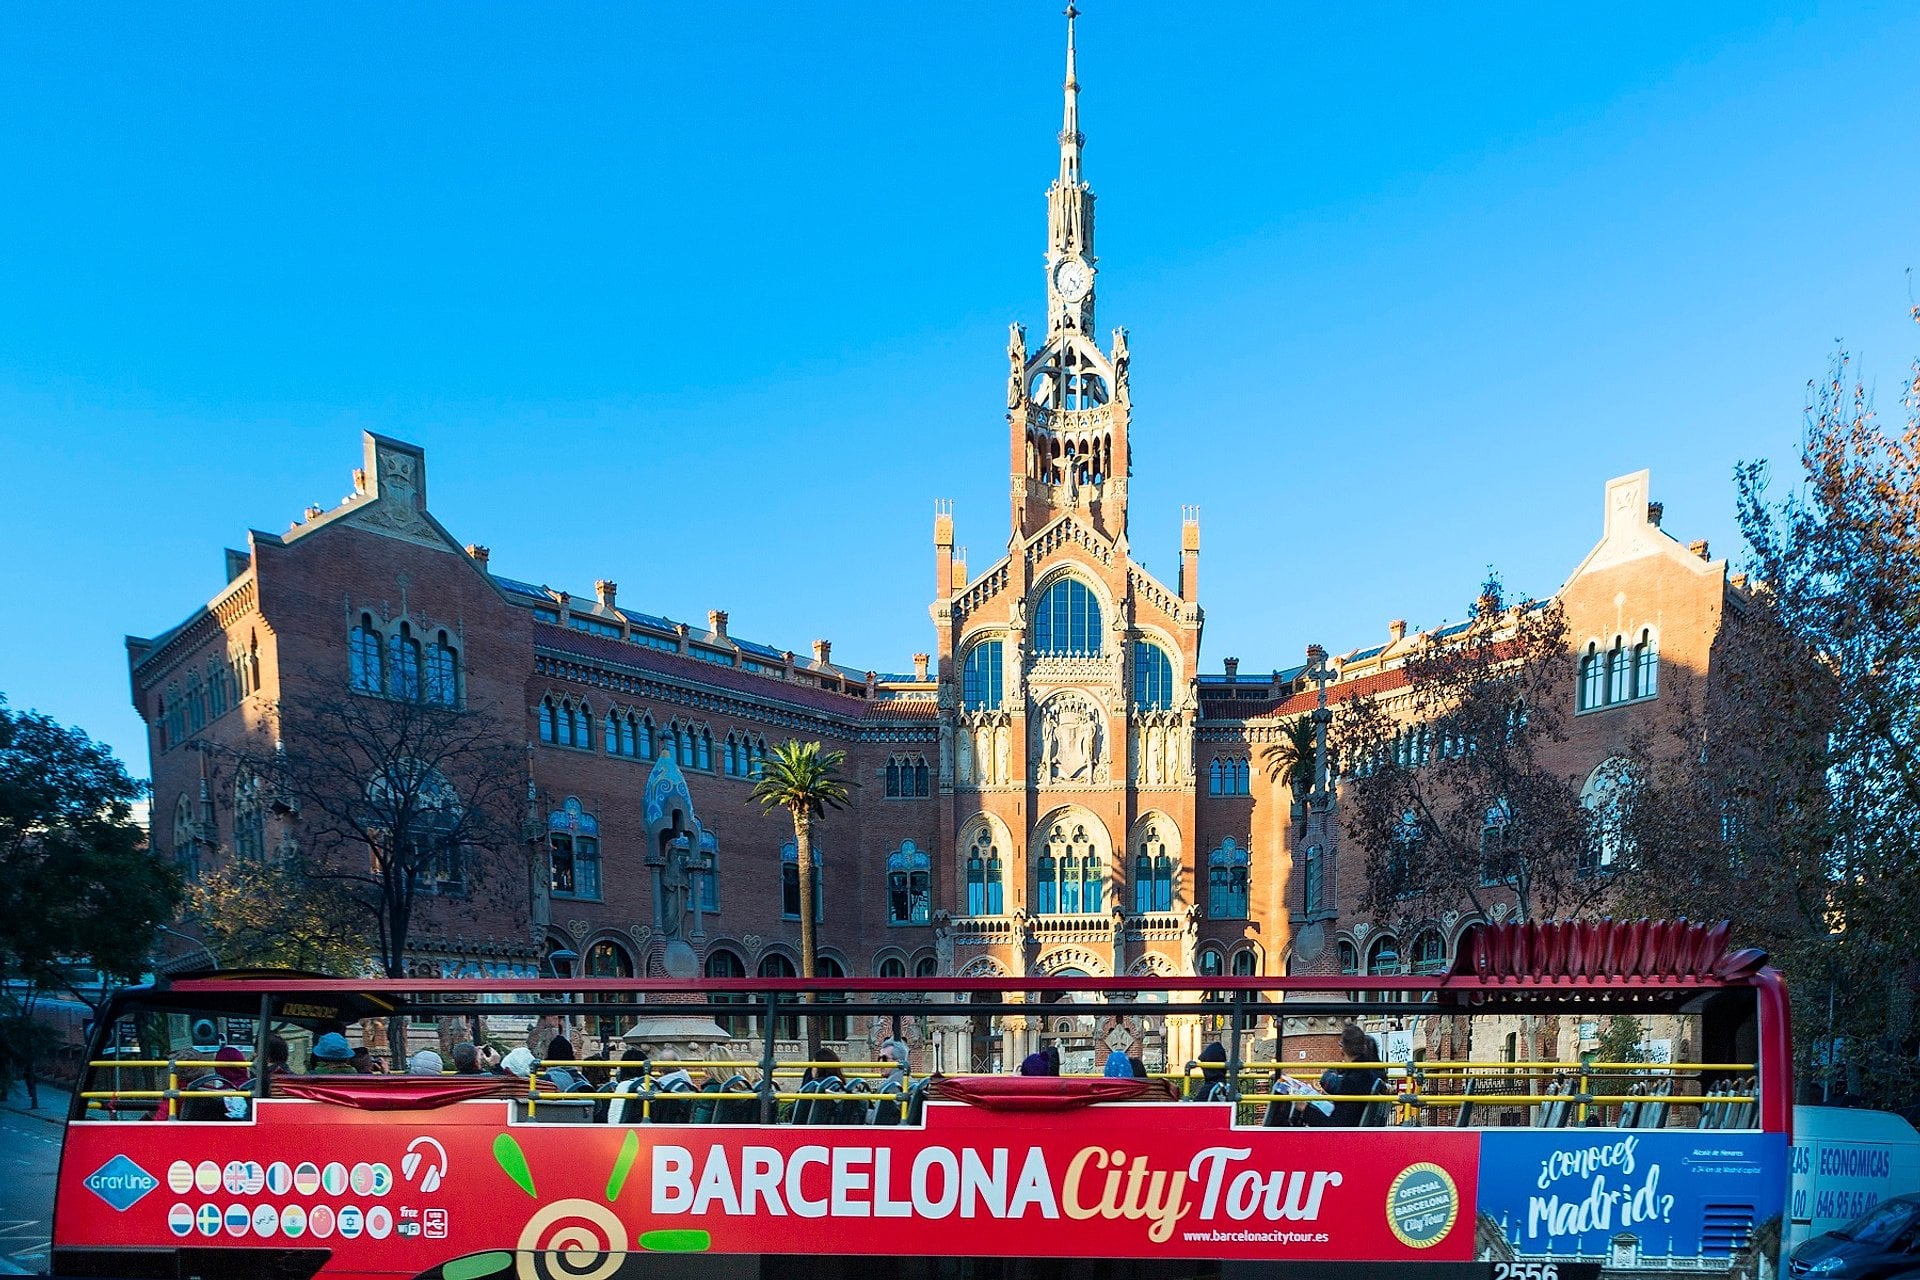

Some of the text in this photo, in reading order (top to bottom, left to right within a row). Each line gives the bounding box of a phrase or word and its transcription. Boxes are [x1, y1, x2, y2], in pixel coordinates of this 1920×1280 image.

[1820, 1148, 1890, 1178] ECONOMICAS
[651, 1144, 1343, 1243] BARCELONA City Tour
[1399, 1181, 1441, 1199] OFFICIAL
[1528, 1163, 1674, 1239] Madrid?
[1395, 1195, 1450, 1217] BARCELONA
[1816, 1190, 1835, 1219] 646
[1837, 1190, 1850, 1219] 95
[1183, 1229, 1329, 1245] www.barcelonacitytour.es
[1494, 1262, 1559, 1280] 2556
